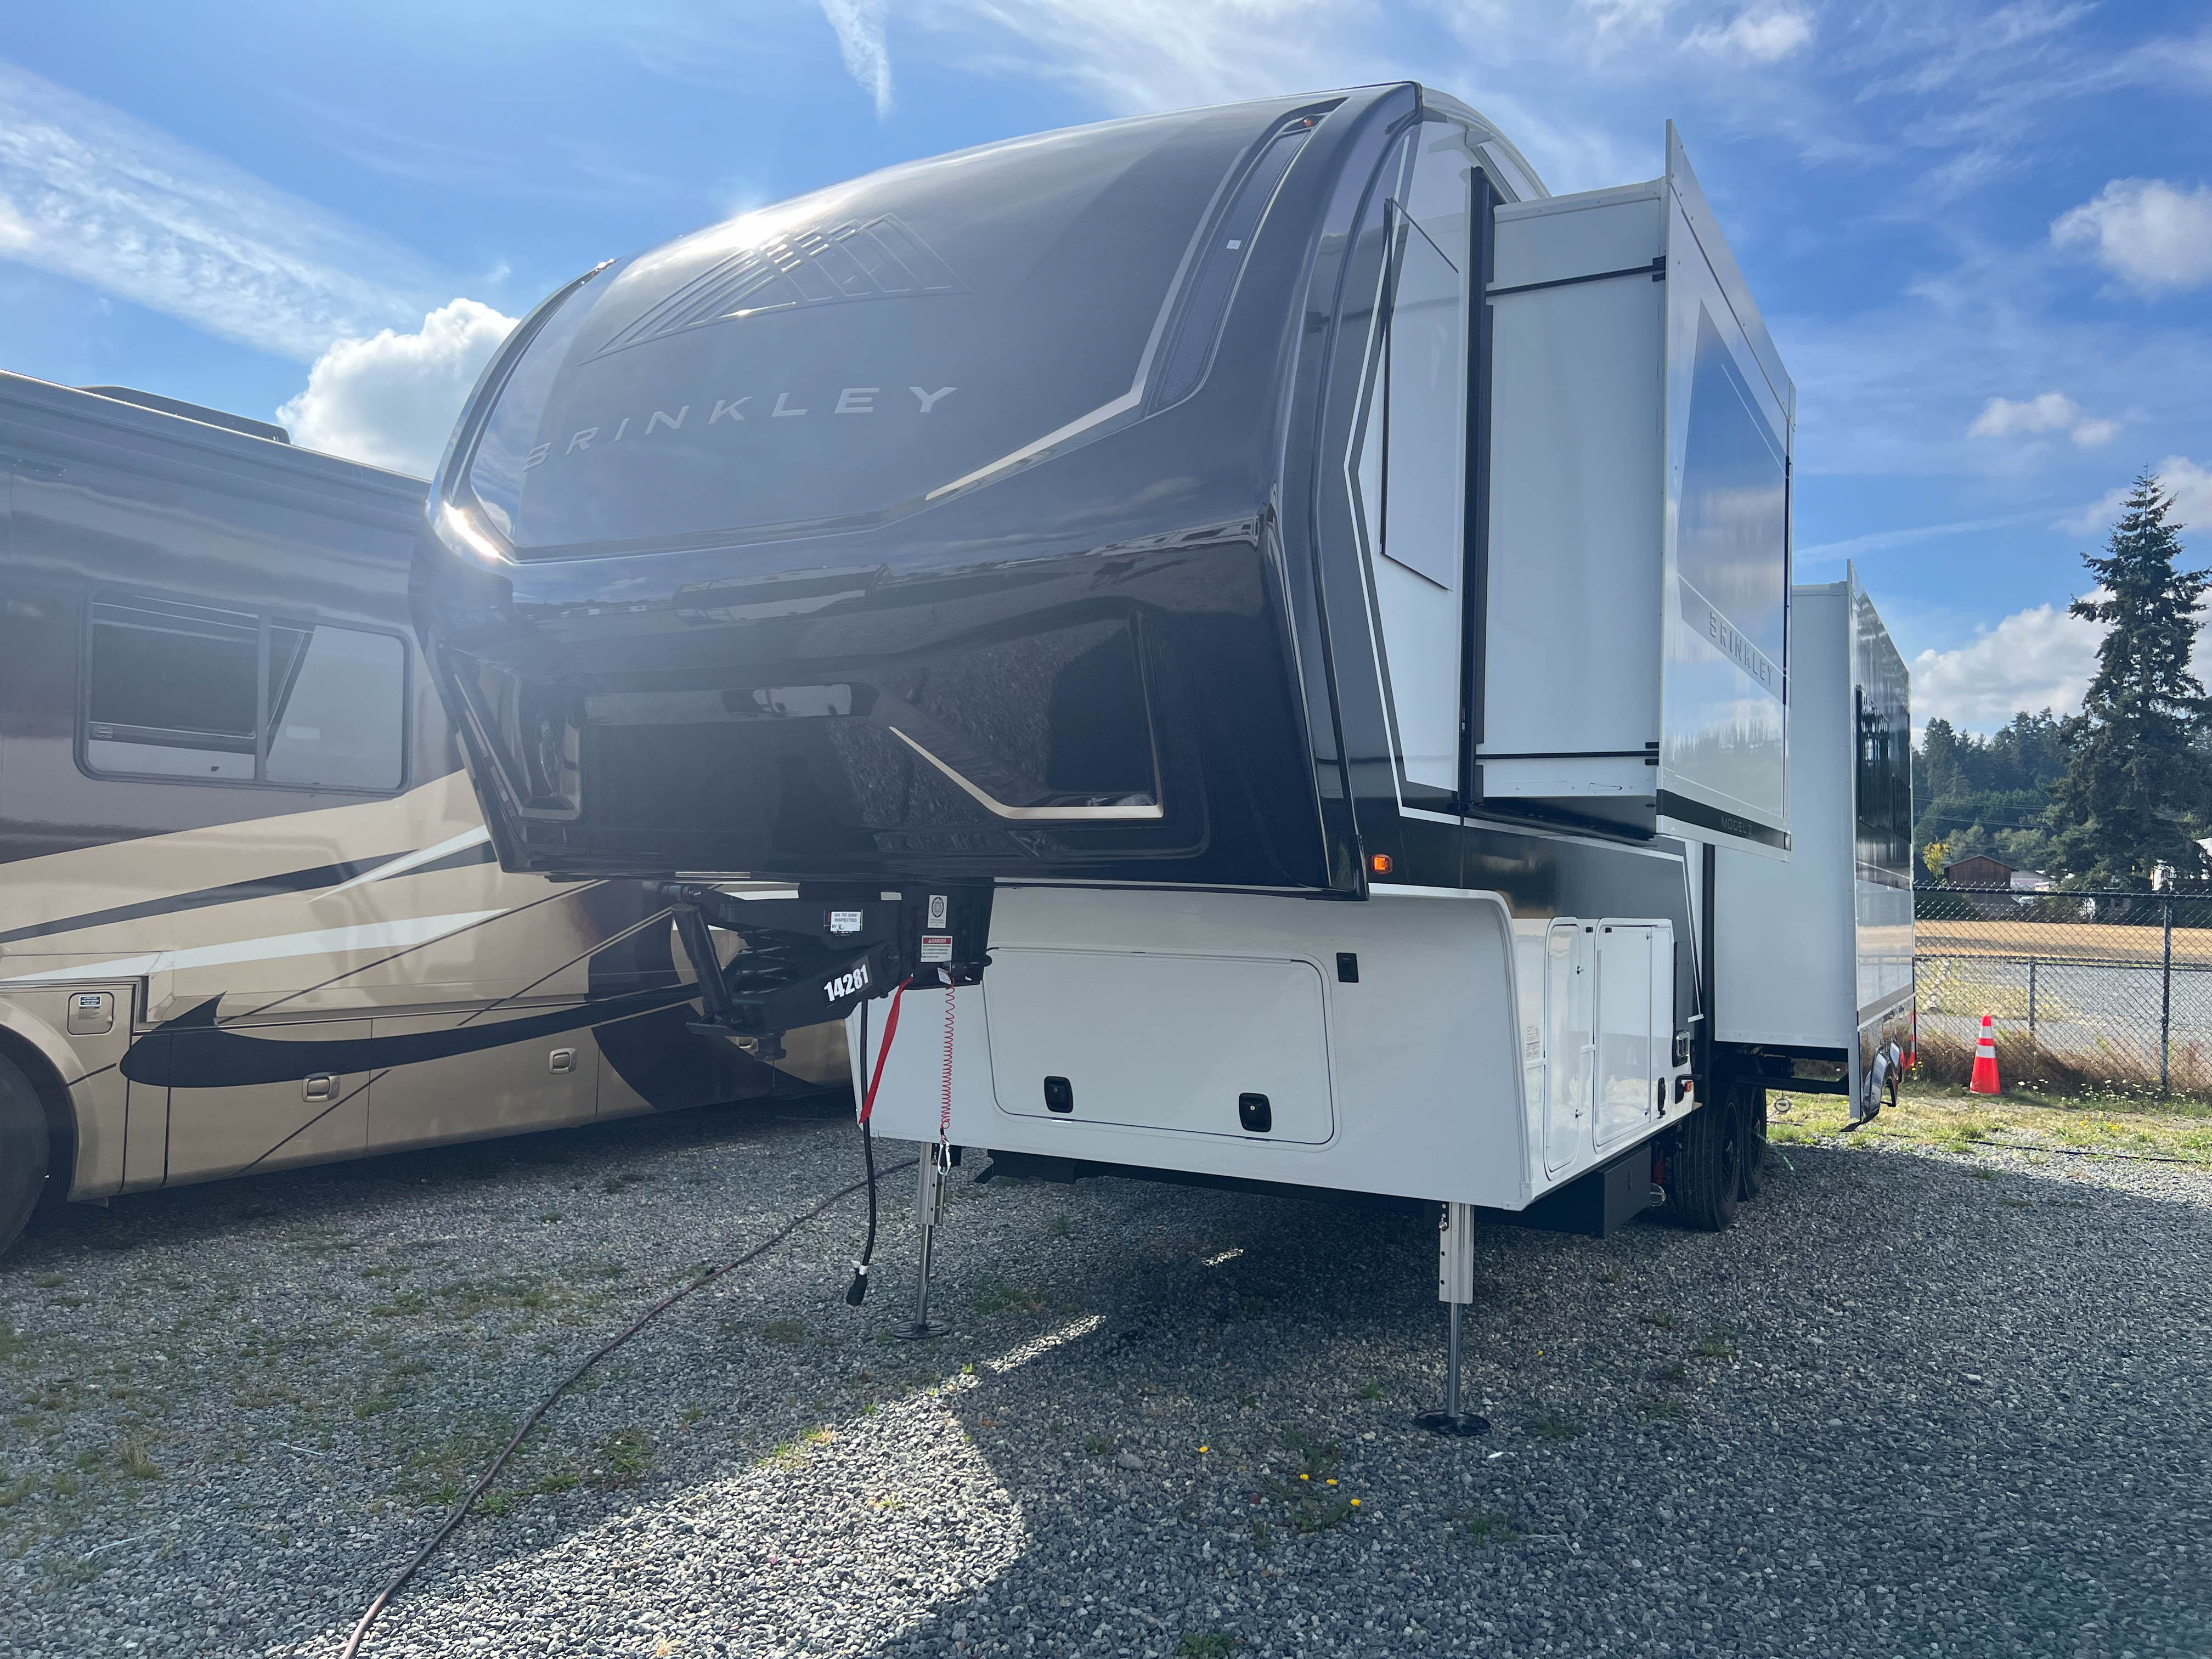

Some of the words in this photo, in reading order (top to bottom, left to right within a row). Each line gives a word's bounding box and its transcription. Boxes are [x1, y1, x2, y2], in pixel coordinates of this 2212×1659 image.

[523, 386, 957, 473] BRINKLEY
[1709, 611, 1772, 686] BRINKLEY
[1721, 816, 1747, 834] MODEL
[824, 964, 868, 1002] 14281
